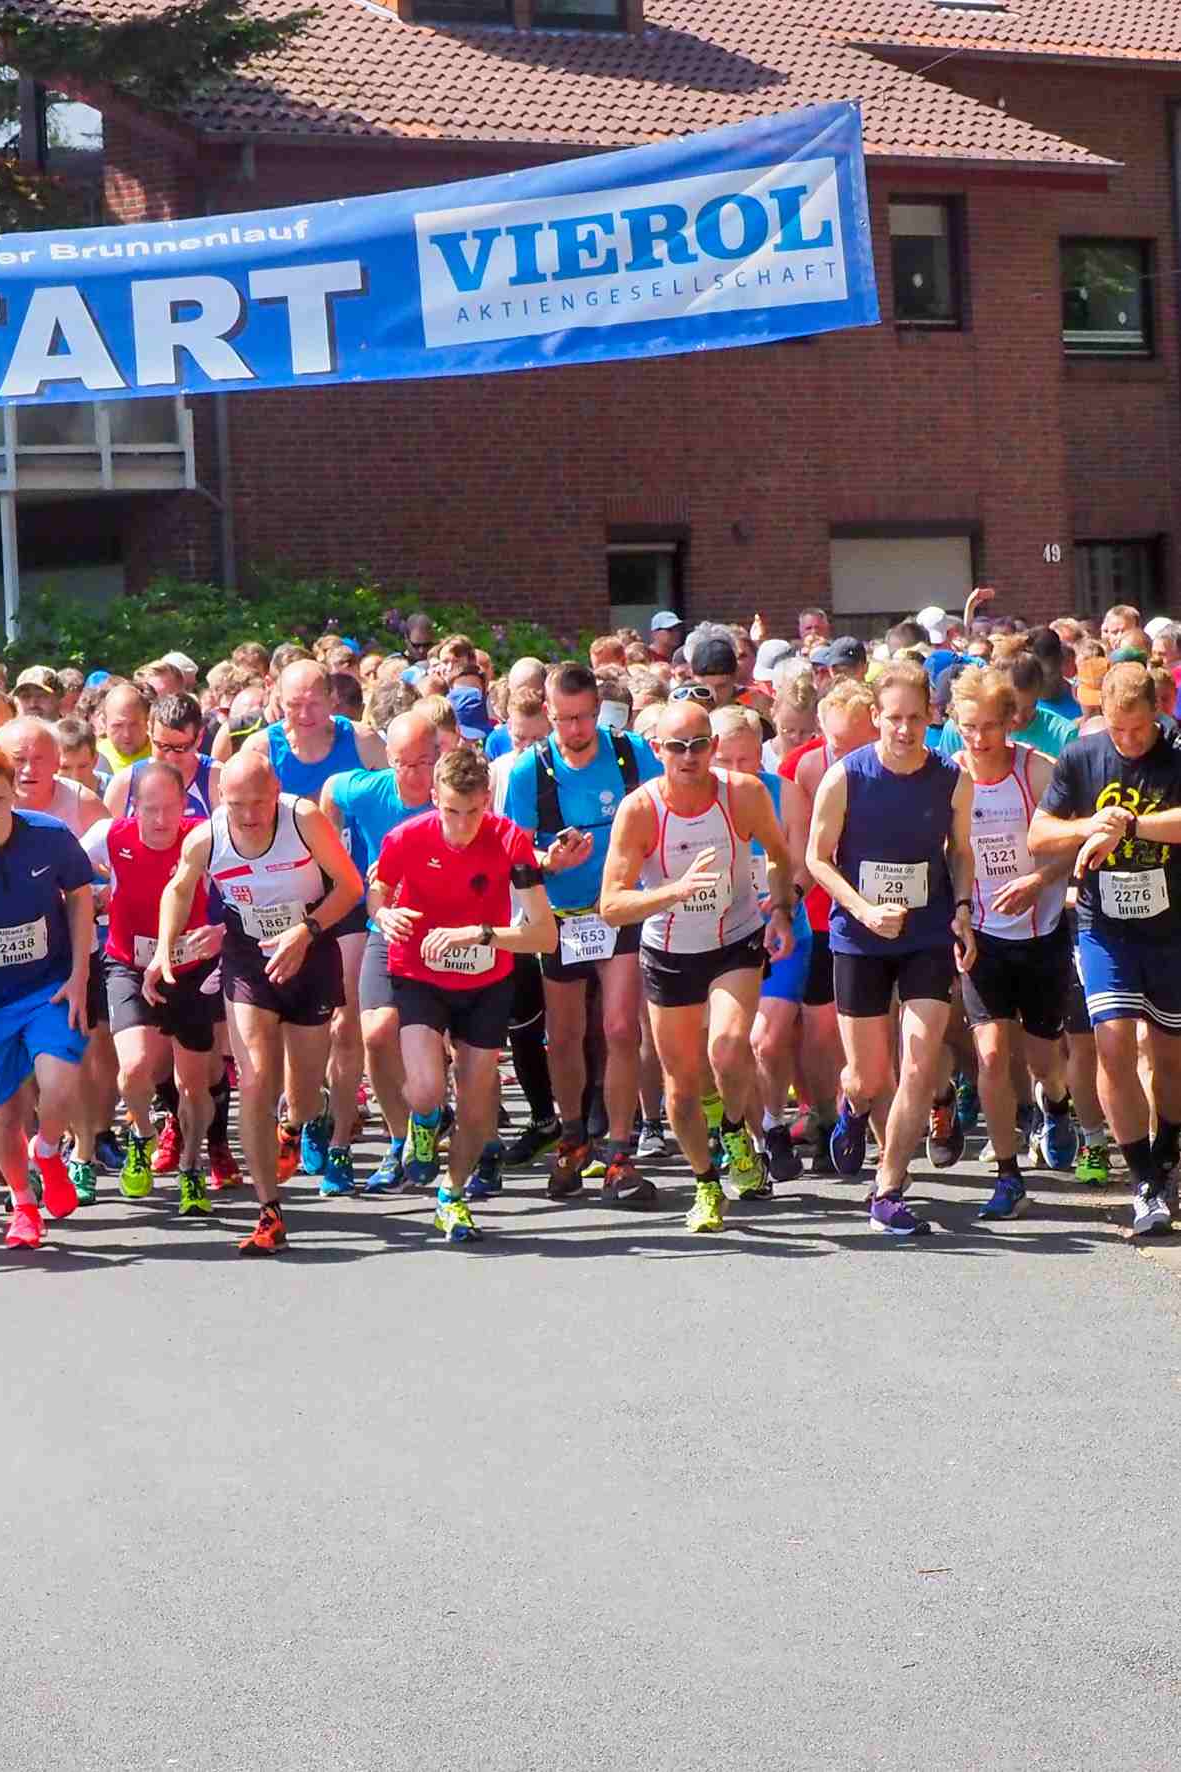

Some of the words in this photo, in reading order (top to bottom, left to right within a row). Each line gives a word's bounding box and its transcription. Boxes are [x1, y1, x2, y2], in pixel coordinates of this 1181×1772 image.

[50, 218, 309, 261] Brunnenlauf
[430, 184, 833, 293] VIEROL
[456, 261, 837, 324] AKTIENGESELLSCHAFT
[981, 849, 1017, 865] 1321
[985, 862, 1019, 876] bruns
[885, 881, 904, 893] 29
[1114, 888, 1152, 902] 2276
[258, 916, 292, 928] 1867
[0, 937, 35, 953] 2438
[443, 945, 478, 959] 2071
[444, 958, 476, 970] bruns
